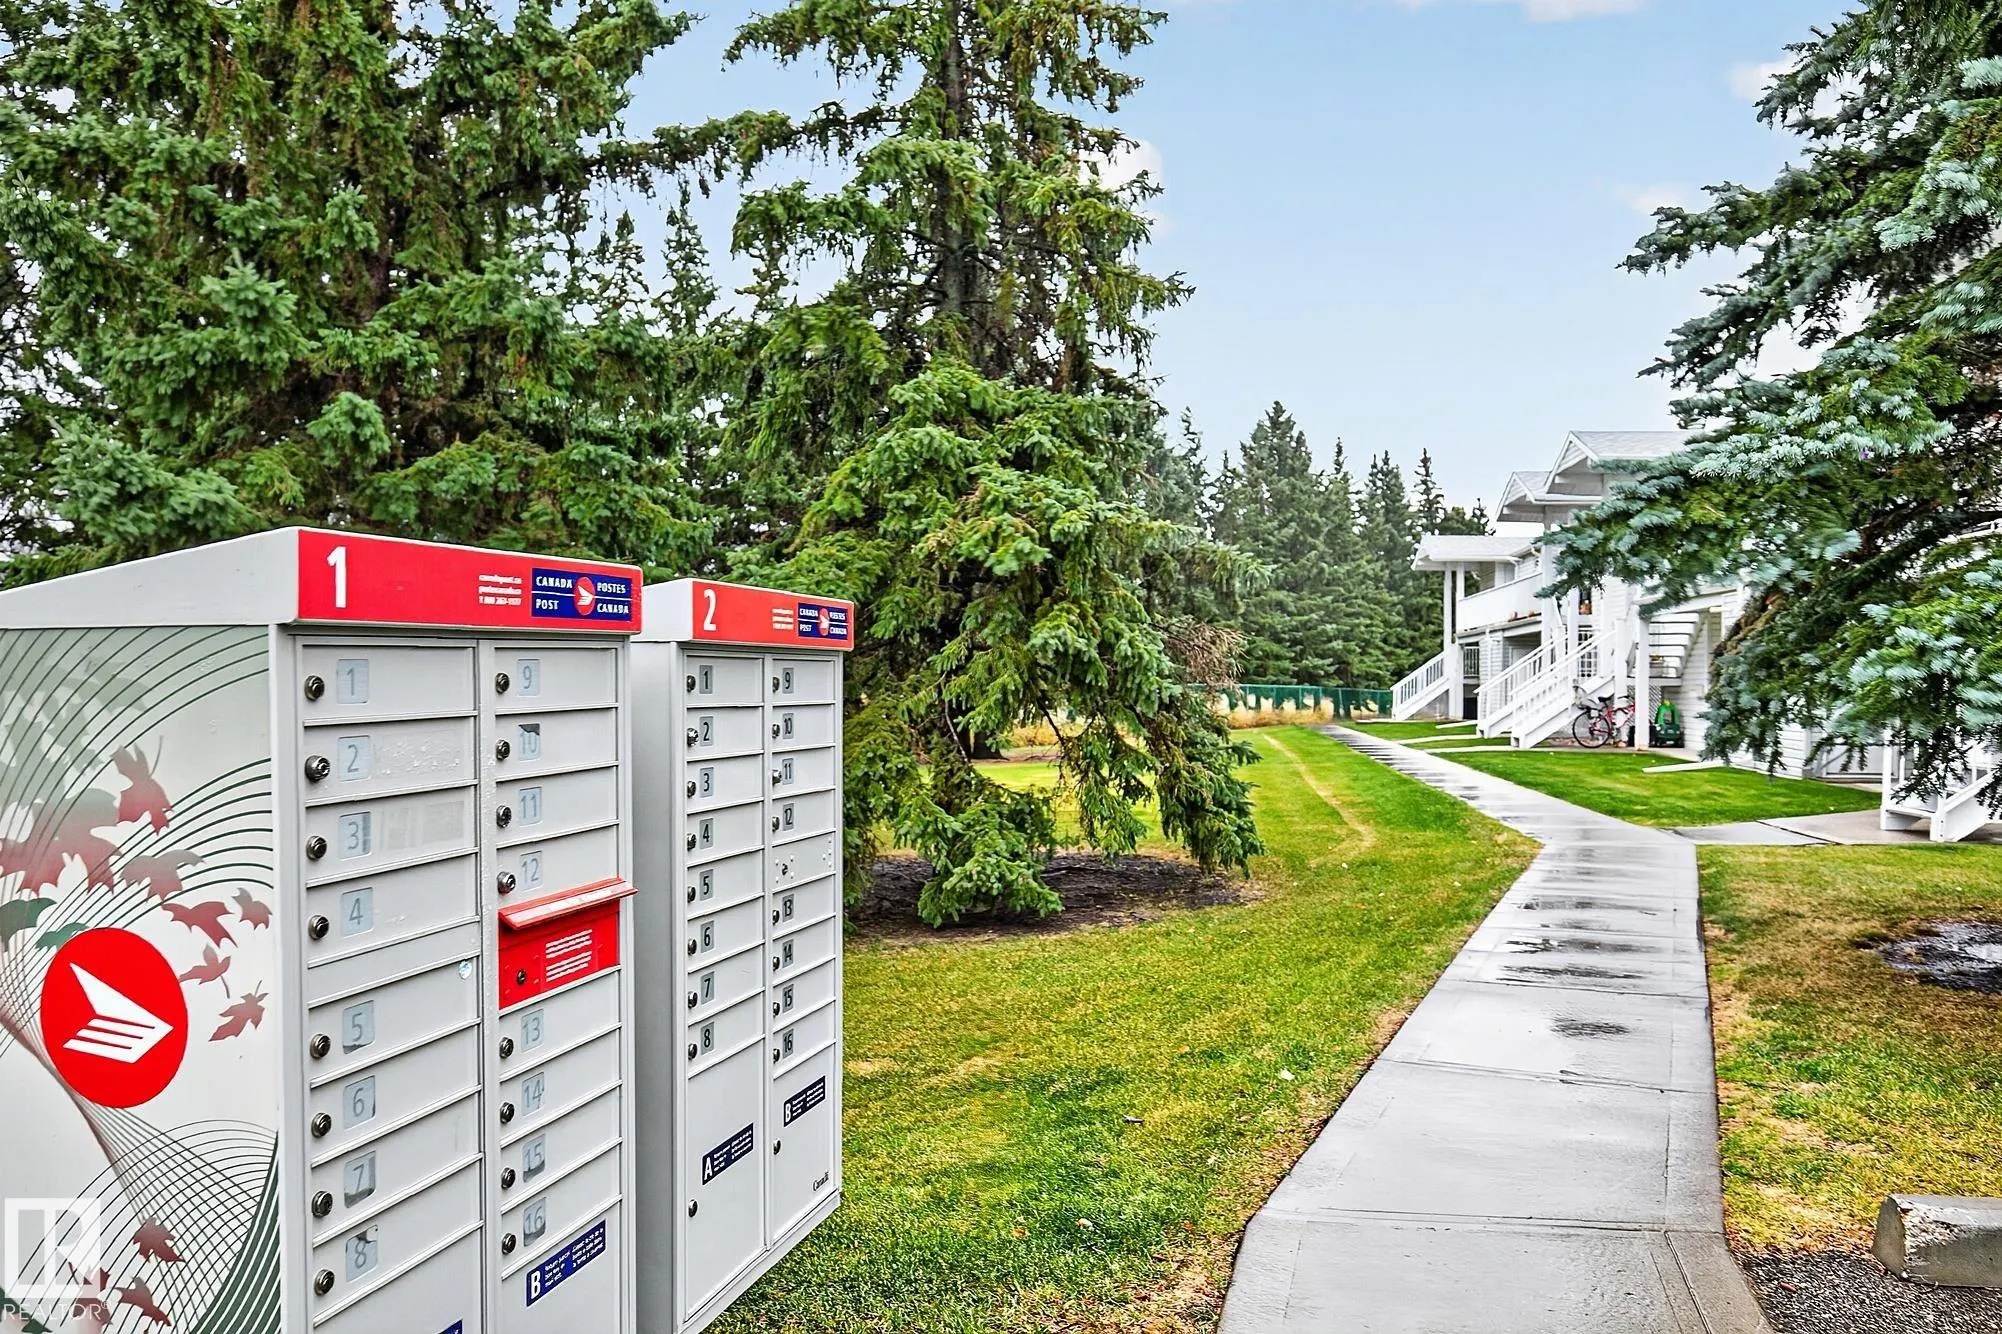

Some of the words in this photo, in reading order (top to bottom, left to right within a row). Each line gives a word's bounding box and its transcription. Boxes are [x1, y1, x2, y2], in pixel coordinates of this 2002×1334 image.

[327, 546, 347, 608] 1
[536, 576, 573, 588] CANADA
[597, 582, 626, 594] POSTES
[536, 599, 560, 610] POST
[597, 603, 629, 614] CANADA
[704, 589, 716, 631] 2
[346, 667, 355, 696] 1
[523, 665, 533, 690] 9
[703, 670, 709, 690] 1
[785, 671, 791, 690] 9
[703, 721, 710, 741] 2
[784, 717, 792, 735] 10
[520, 731, 538, 754] 10
[347, 743, 359, 773] 2
[703, 772, 710, 792] 3
[784, 763, 792, 780] 11
[520, 795, 537, 820] 11
[784, 807, 793, 826] 12
[348, 820, 360, 850] 3
[703, 824, 710, 843] 4
[521, 858, 540, 885] 12
[703, 876, 710, 895] 5
[348, 897, 363, 926] 4
[783, 900, 792, 917] 13
[704, 927, 711, 947] 6
[783, 944, 792, 962] 14
[704, 978, 711, 998] 7
[783, 989, 792, 1008] 15
[351, 1012, 363, 1042] 5
[522, 1016, 541, 1045] 13
[704, 1028, 711, 1048] 8
[783, 1033, 792, 1053] 16
[352, 1087, 365, 1117] 6
[524, 1078, 543, 1108] 14
[785, 1102, 792, 1123] B
[525, 1143, 543, 1170] 15
[353, 1163, 365, 1192] 7
[704, 1157, 713, 1181] A
[525, 1206, 543, 1234] 16
[355, 1238, 367, 1268] 8
[531, 1271, 541, 1299] B
